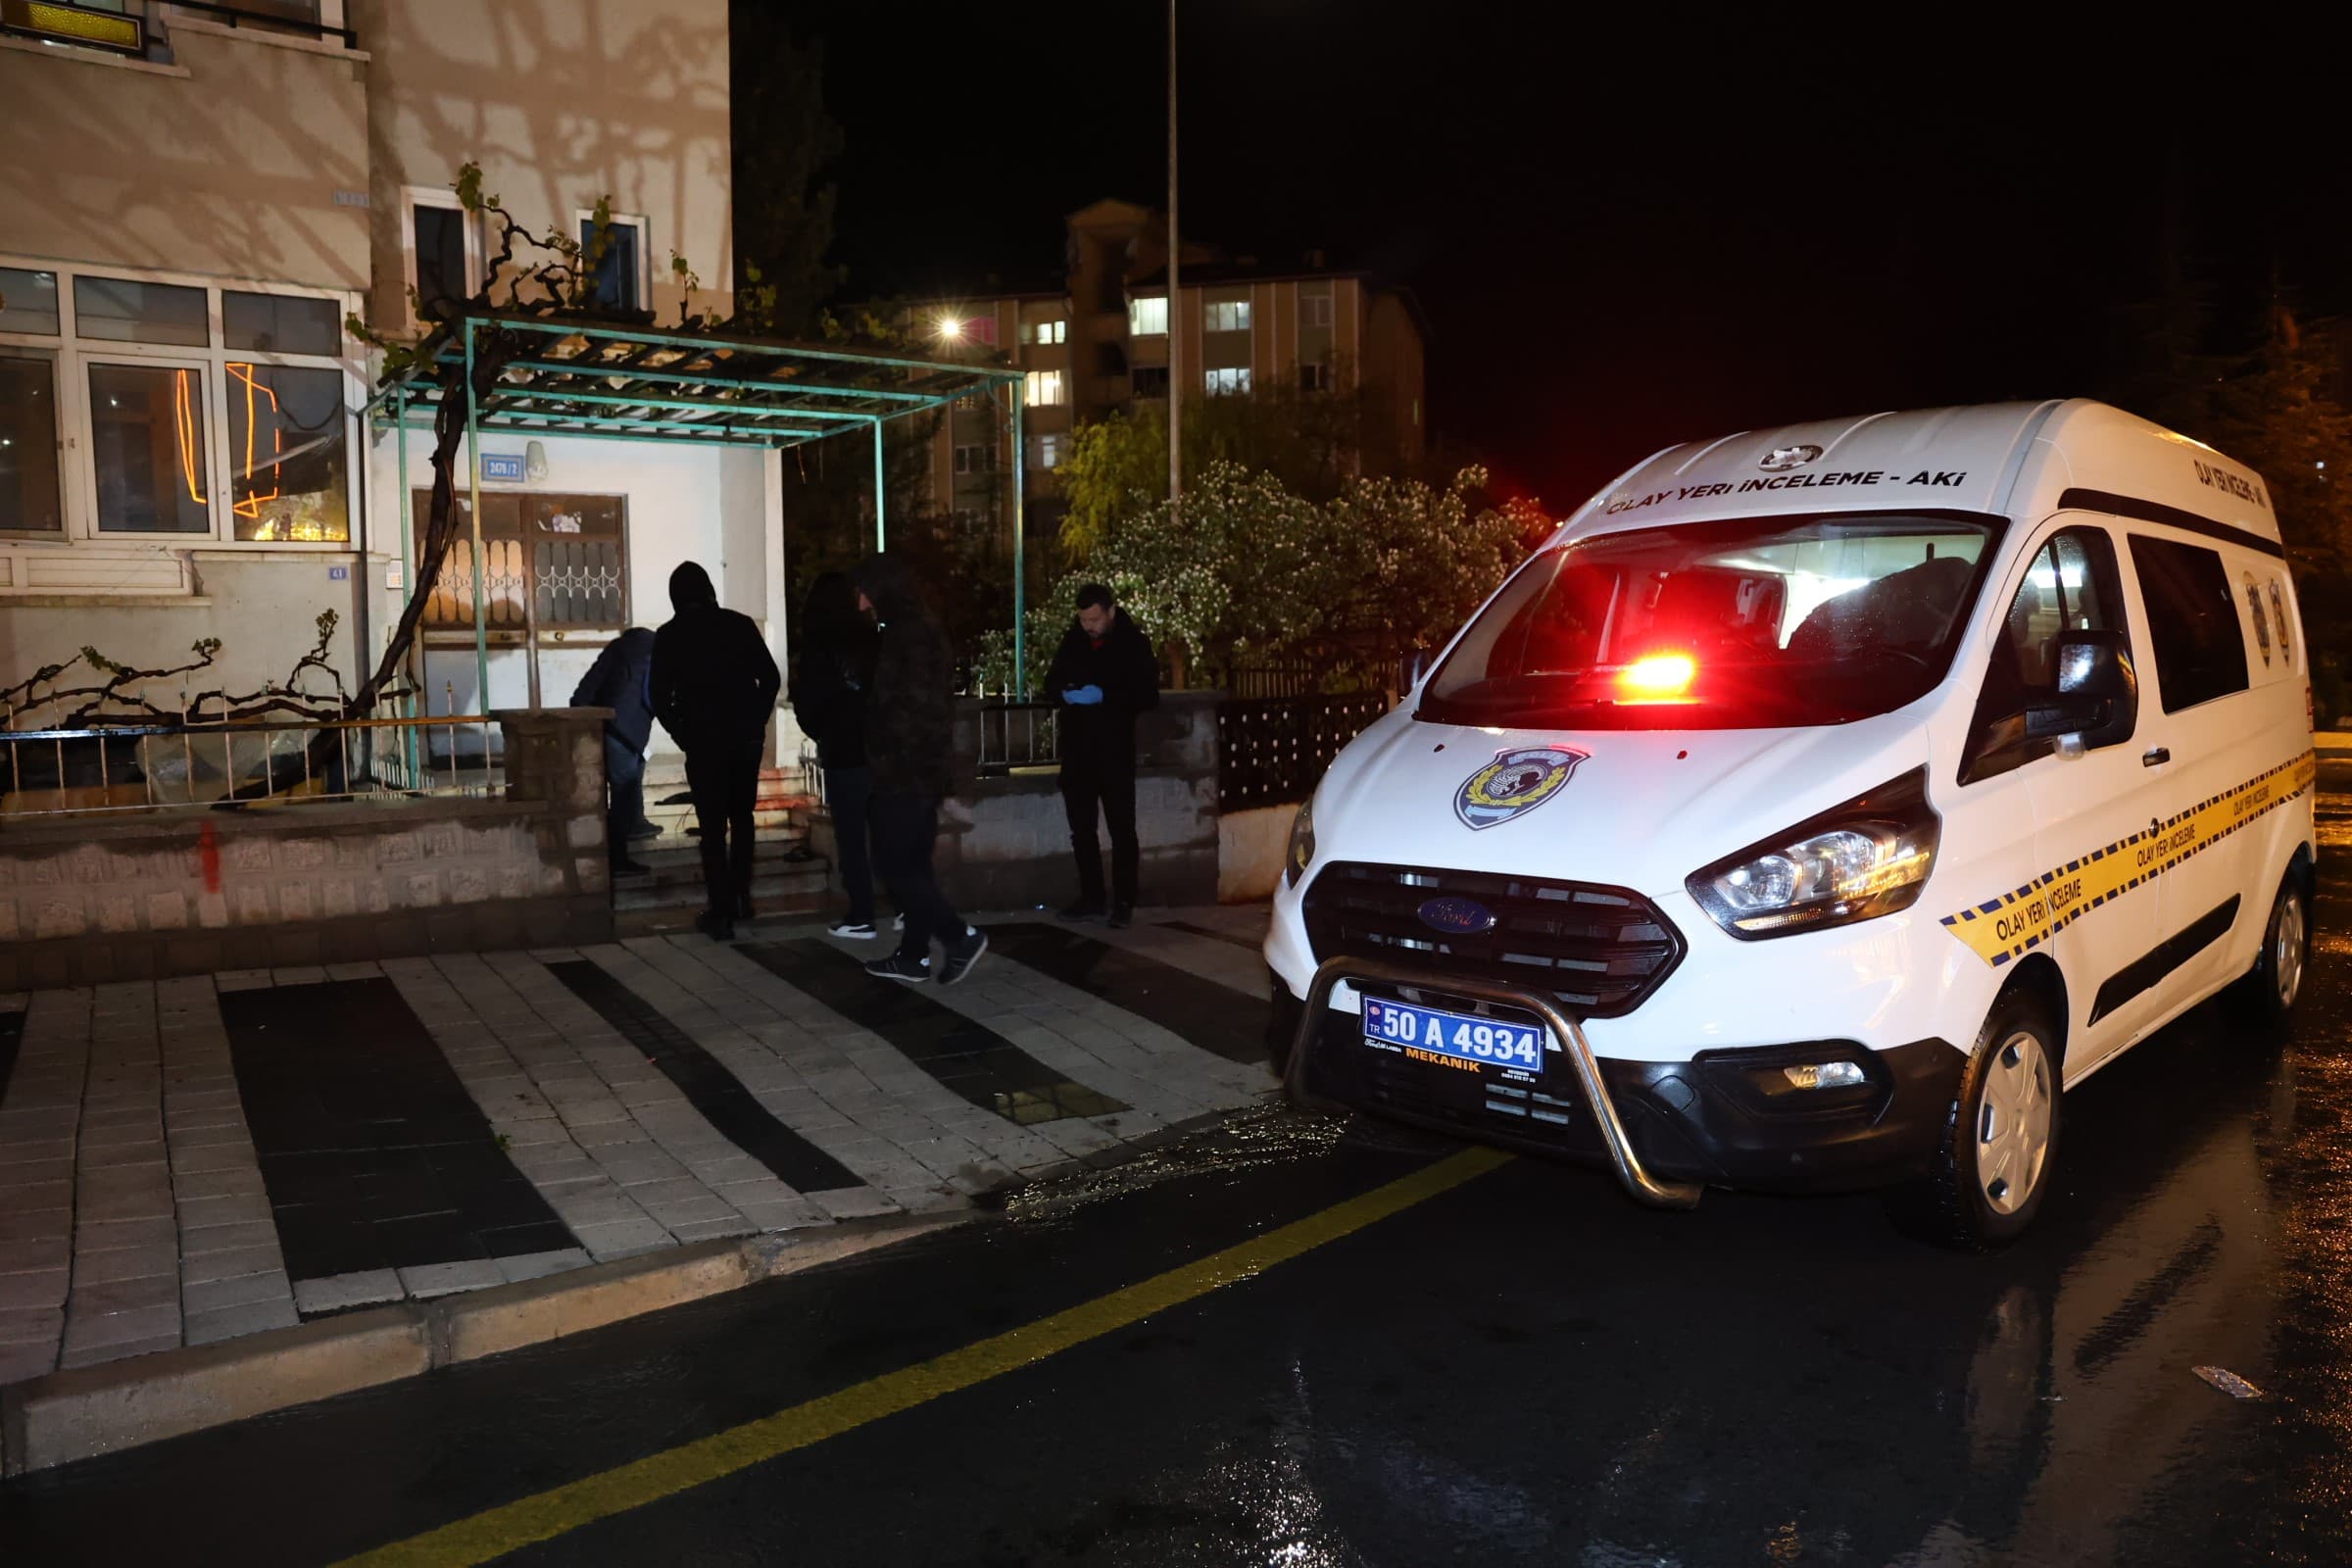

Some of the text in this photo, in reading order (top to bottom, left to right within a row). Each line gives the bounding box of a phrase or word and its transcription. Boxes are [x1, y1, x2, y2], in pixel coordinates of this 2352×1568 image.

[1606, 490, 1673, 515] OLAY
[2136, 845, 2155, 868] OLAY
[1996, 909, 2026, 941] OLAY
[1369, 1023, 1381, 1035] TR
[1384, 1007, 1417, 1042] 50
[1424, 1017, 1445, 1049] A
[1452, 1023, 1537, 1064] 4934
